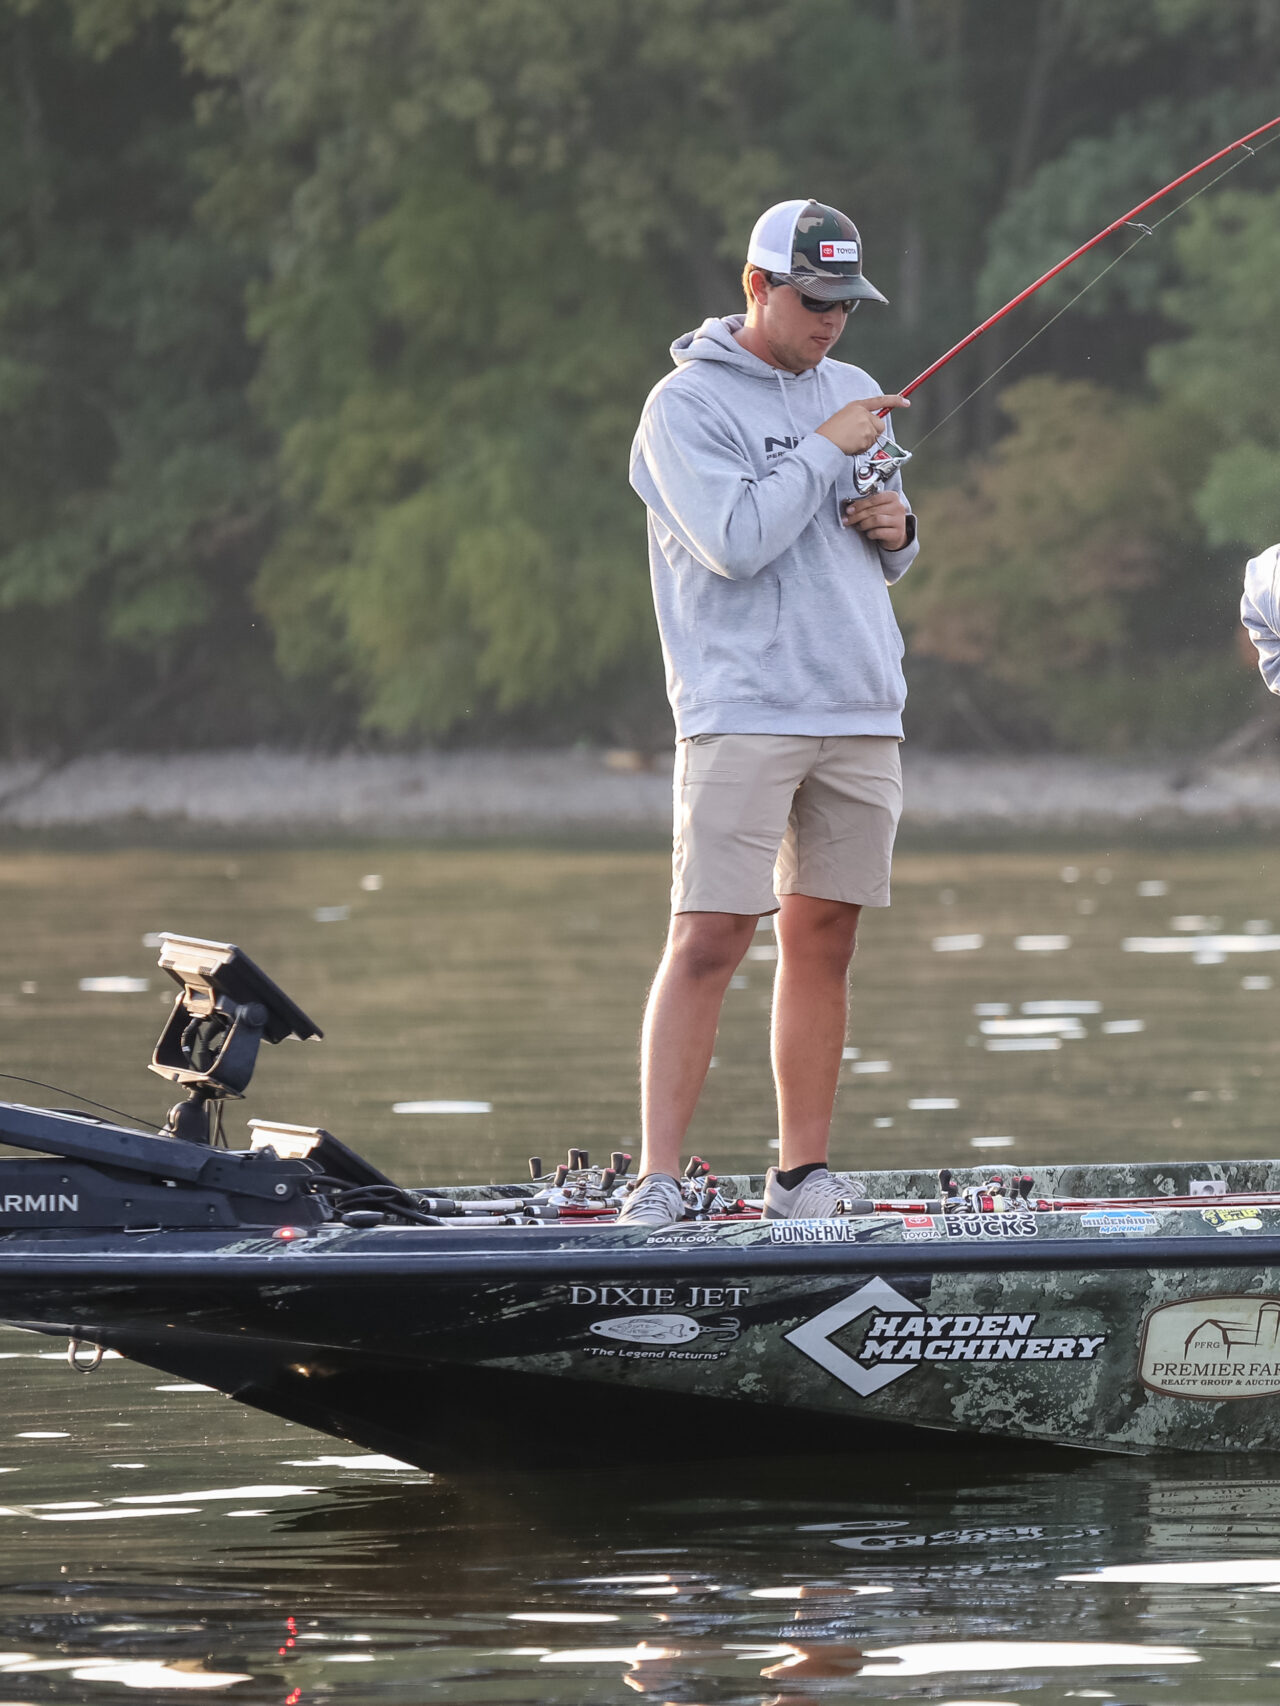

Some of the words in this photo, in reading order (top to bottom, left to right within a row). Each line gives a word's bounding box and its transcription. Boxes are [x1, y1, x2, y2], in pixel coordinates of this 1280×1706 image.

[836, 247, 857, 255] TOYOTA
[0, 1194, 79, 1213] RMIN
[1082, 1217, 1156, 1226] MILLENNIUM
[771, 1226, 855, 1242] CONSERVE
[948, 1221, 1038, 1237] BUCKS
[1100, 1225, 1144, 1233] MARINE
[646, 1236, 718, 1244] BOATLOGIX
[902, 1231, 941, 1239] TOYOTA
[570, 1286, 675, 1306] DIXIE
[685, 1287, 750, 1307] JET
[868, 1315, 1036, 1336] HAYDEN
[859, 1338, 1105, 1359] MACHINERY
[1194, 1341, 1221, 1349] PFRG
[618, 1349, 666, 1359] Legend
[1152, 1362, 1246, 1377] PREMIER
[1161, 1378, 1199, 1386] REALTY
